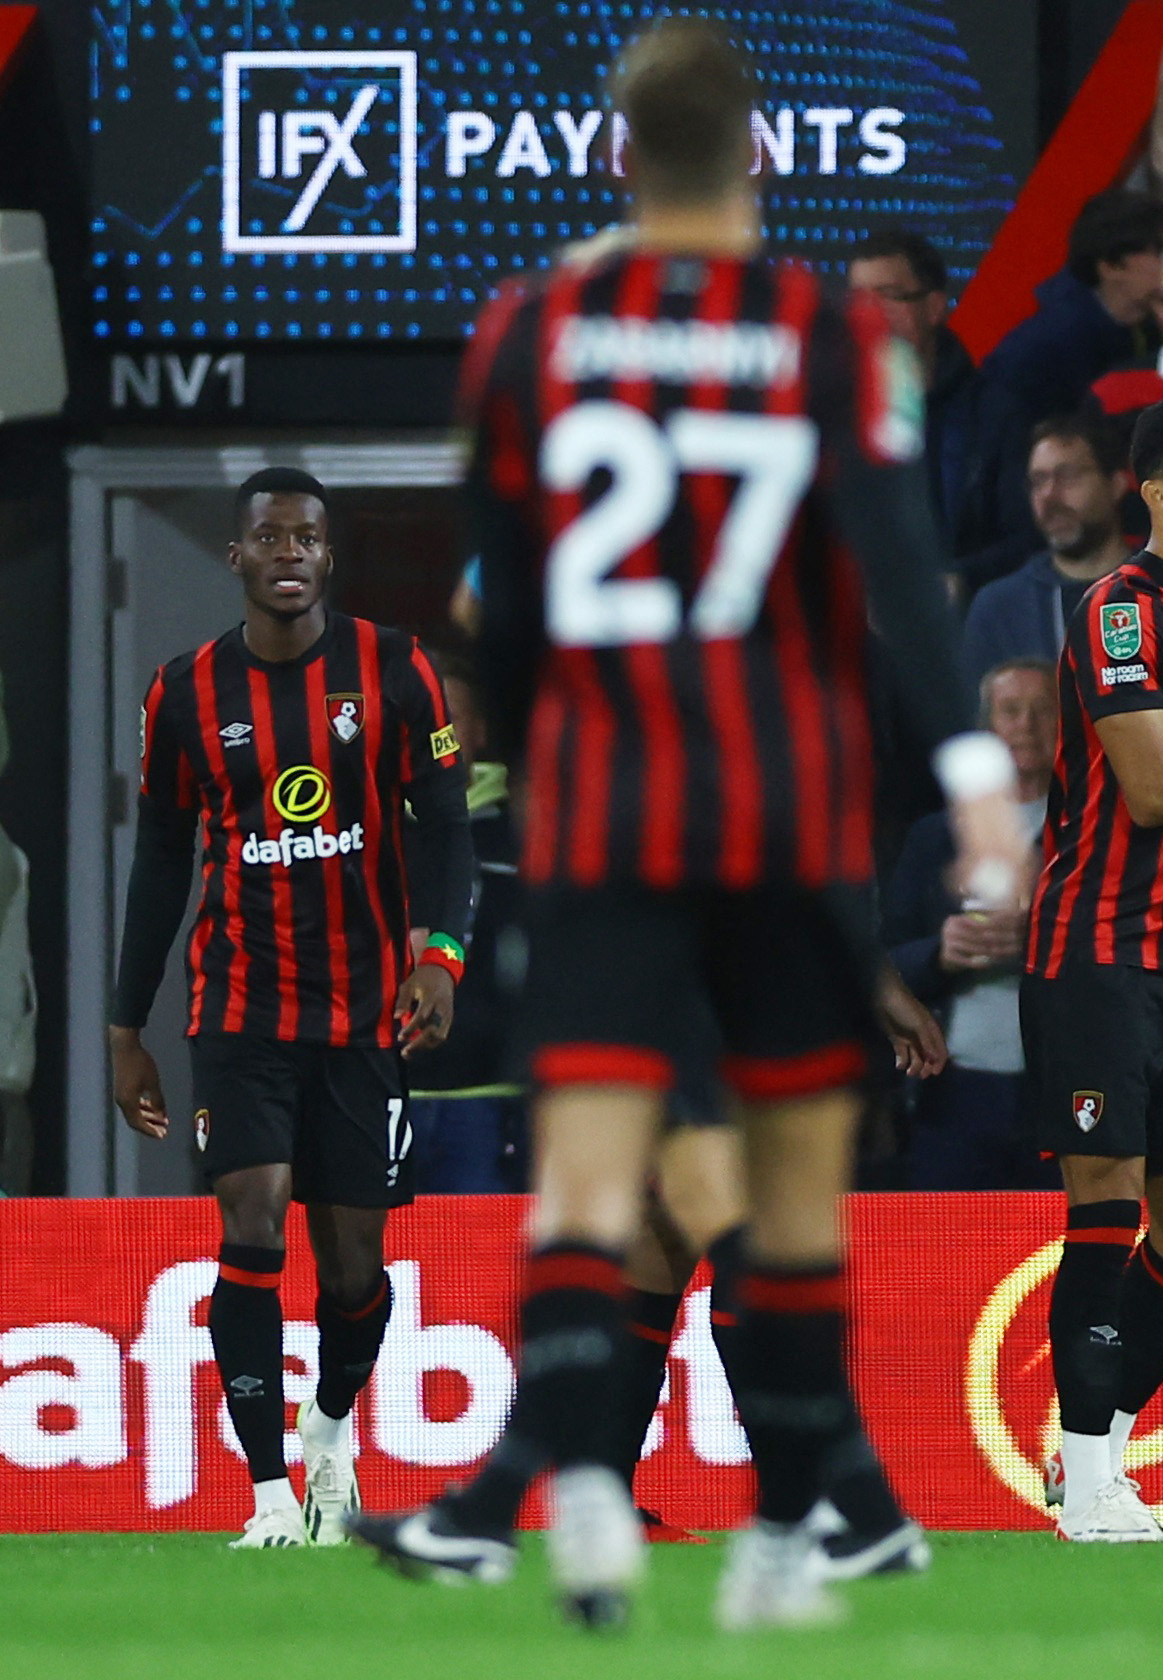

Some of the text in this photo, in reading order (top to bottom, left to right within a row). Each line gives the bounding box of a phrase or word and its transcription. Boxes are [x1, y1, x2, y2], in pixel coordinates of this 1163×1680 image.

[257, 84, 906, 231] IFX PAYNTS
[110, 353, 246, 409] NV1
[537, 397, 822, 649] 27
[1101, 664, 1145, 678] No room
[1102, 671, 1149, 686] for racism
[242, 822, 364, 868] dafabet
